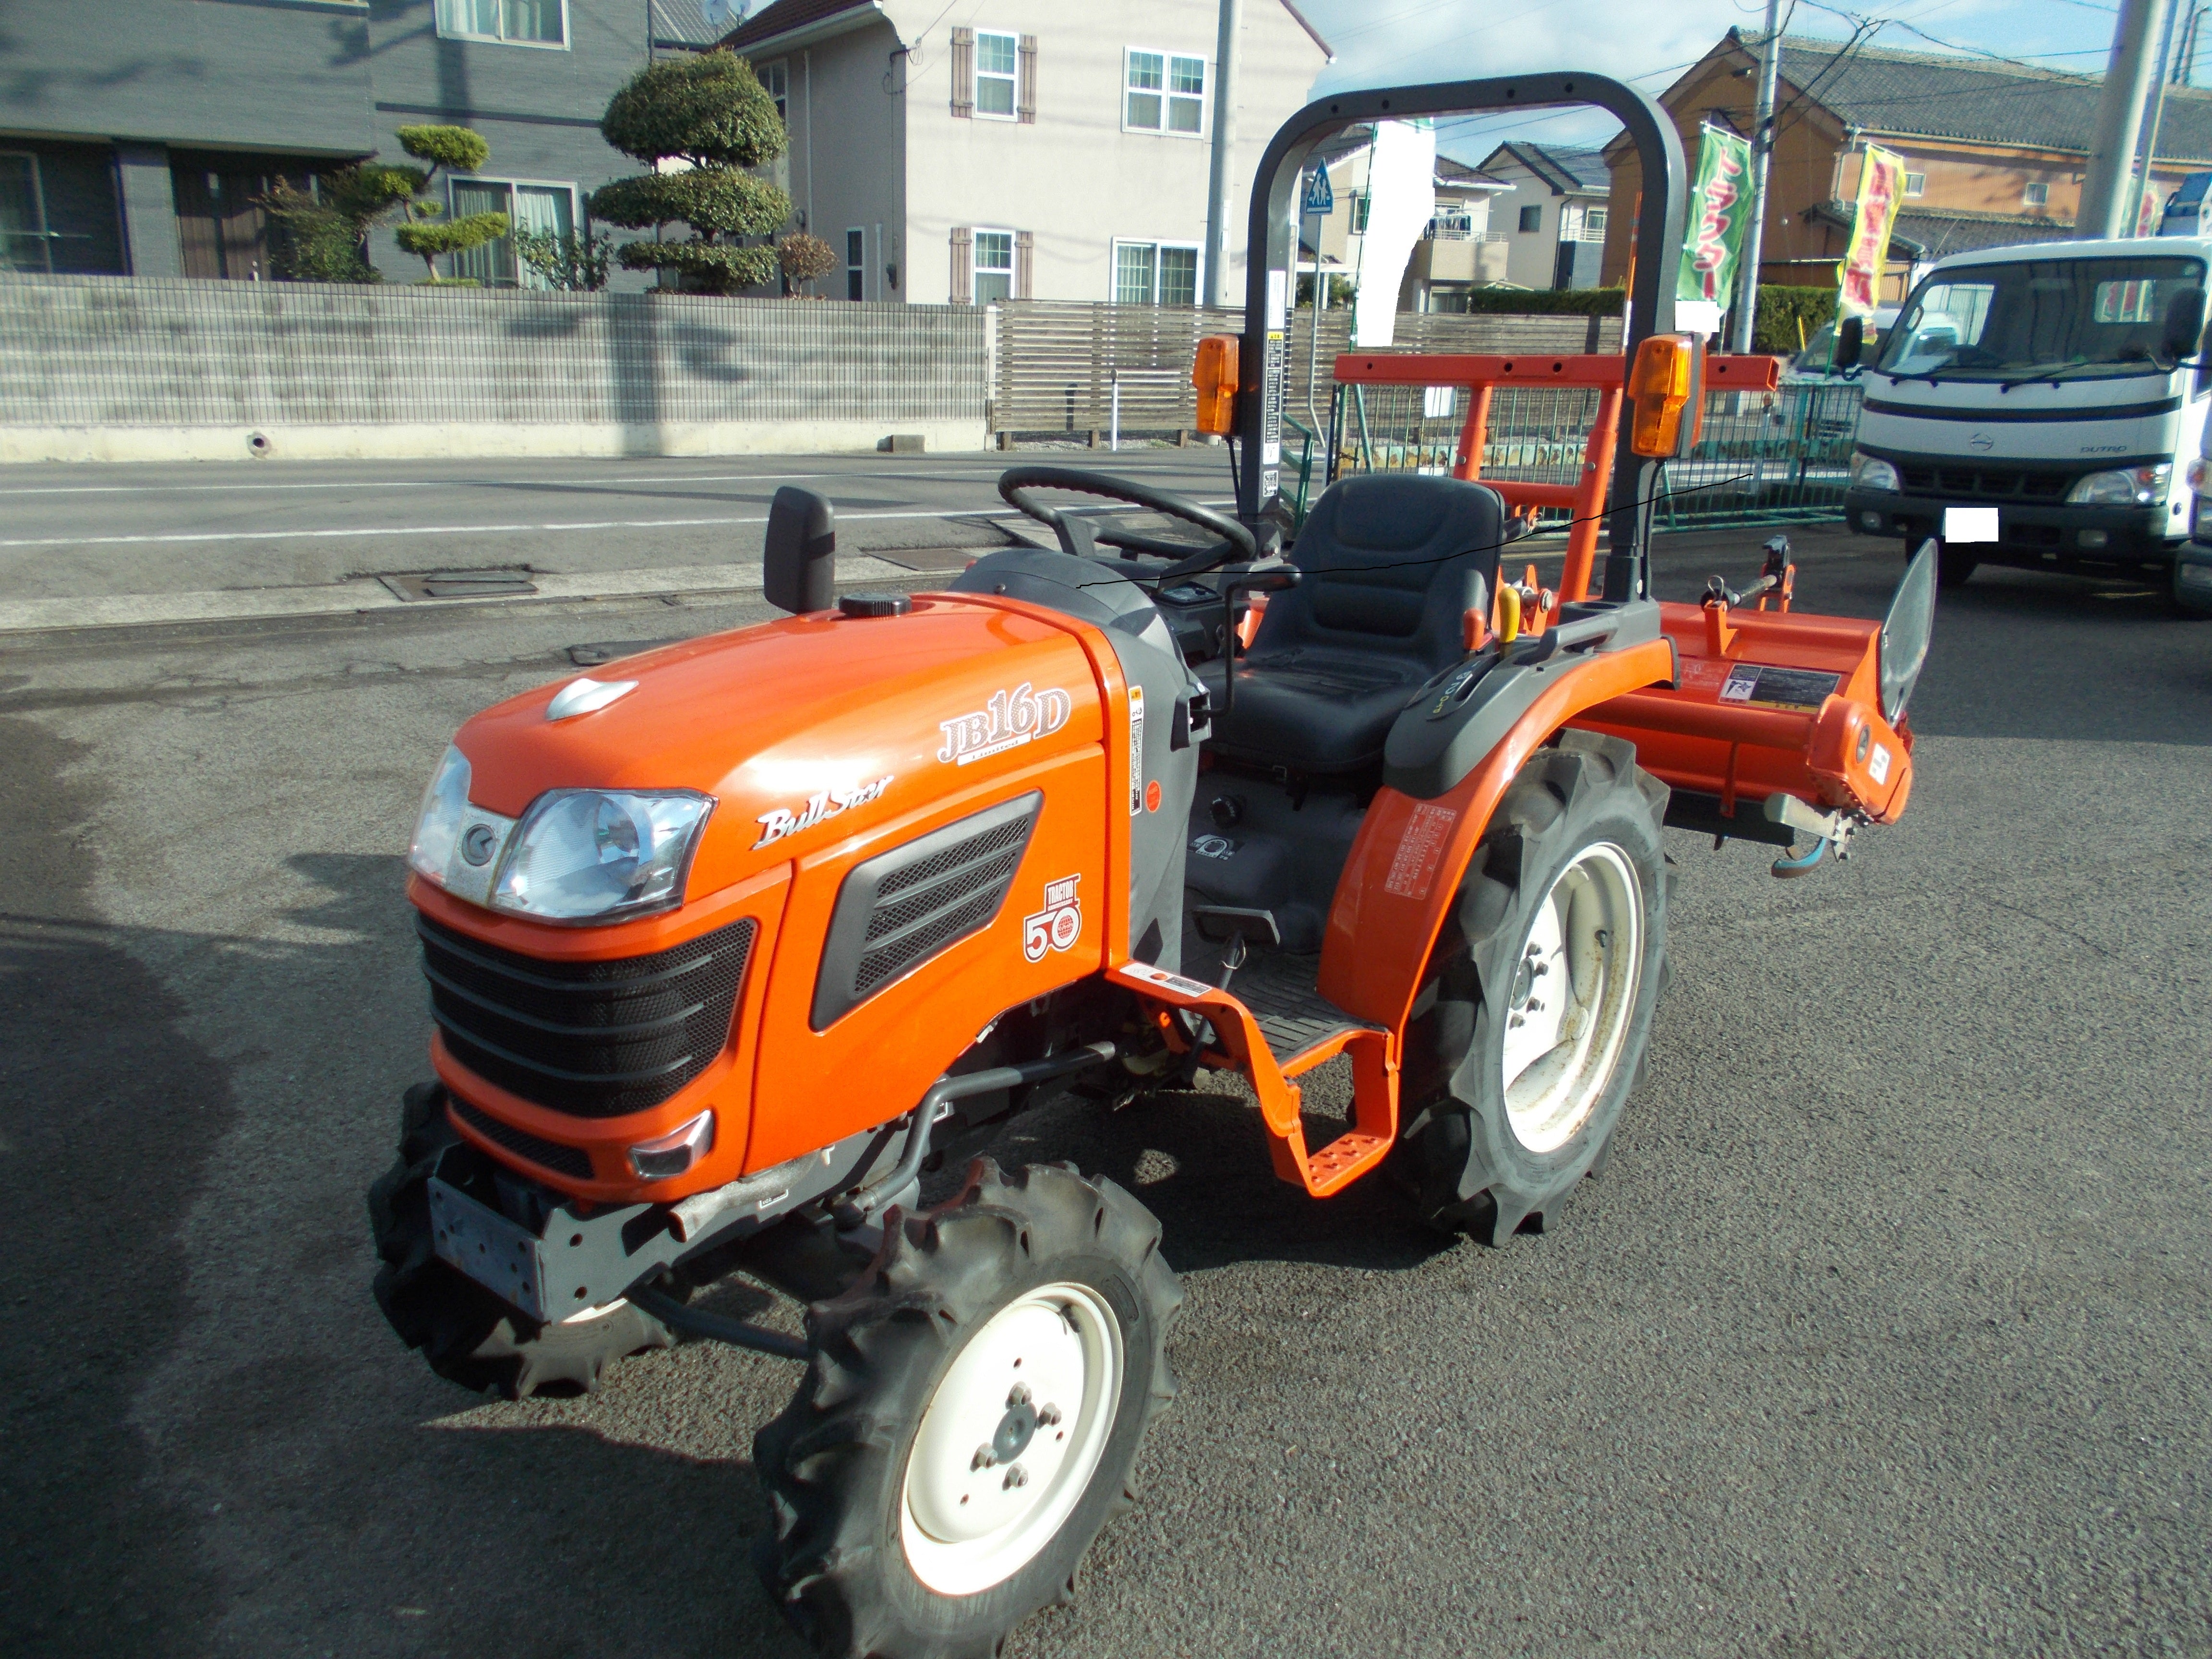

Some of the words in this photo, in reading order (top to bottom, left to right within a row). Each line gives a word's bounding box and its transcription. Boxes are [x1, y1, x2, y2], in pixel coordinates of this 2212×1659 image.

[1693, 146, 1743, 300] トラクター
[937, 682, 1071, 763] JB16D
[972, 740, 1019, 760] Limited
[1047, 879, 1074, 905] TRACTOR
[1047, 898, 1073, 912] ANNIVERSARY
[1026, 907, 1080, 958] 50
